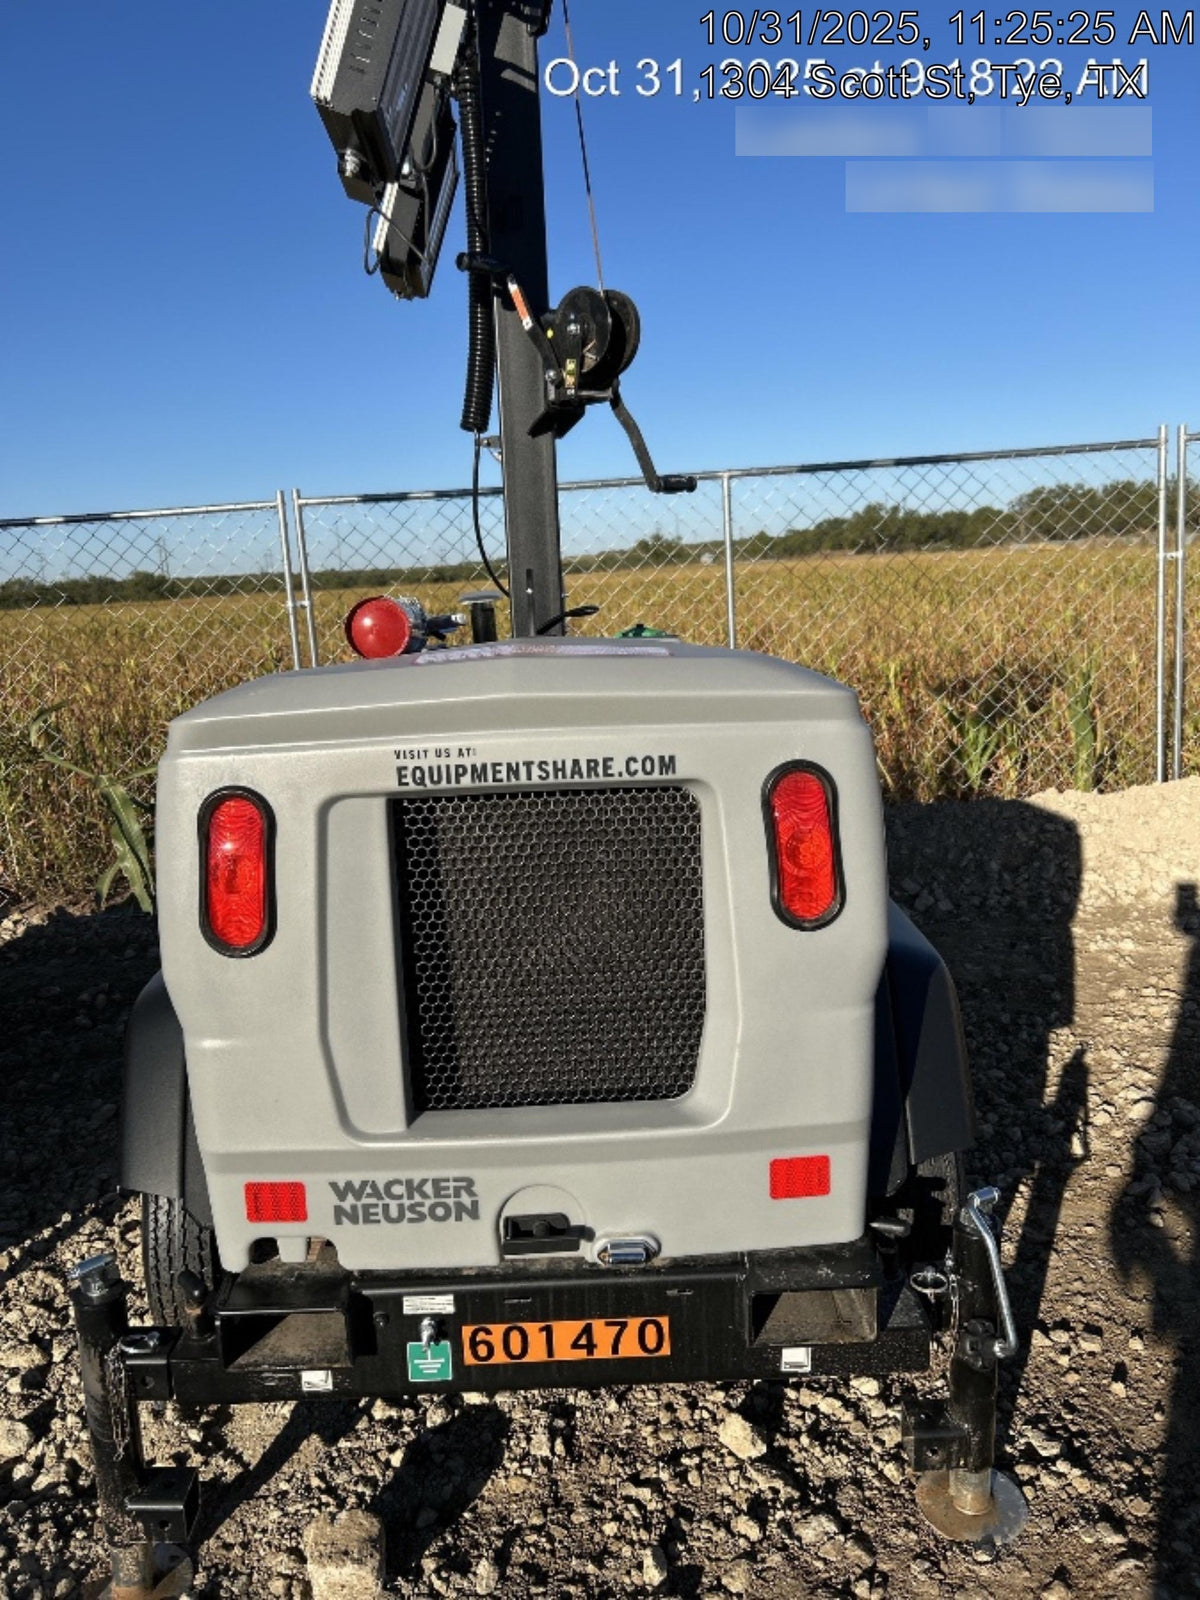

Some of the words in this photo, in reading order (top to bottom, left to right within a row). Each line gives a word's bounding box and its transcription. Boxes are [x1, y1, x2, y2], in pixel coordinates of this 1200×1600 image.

[394, 750, 428, 760] VISIT
[435, 748, 451, 758] US
[396, 754, 677, 787] EQUIPMENTSHARE.COM
[328, 1176, 479, 1202] WACKER
[333, 1199, 480, 1226] NEUSON
[468, 1317, 666, 1363] 601470
